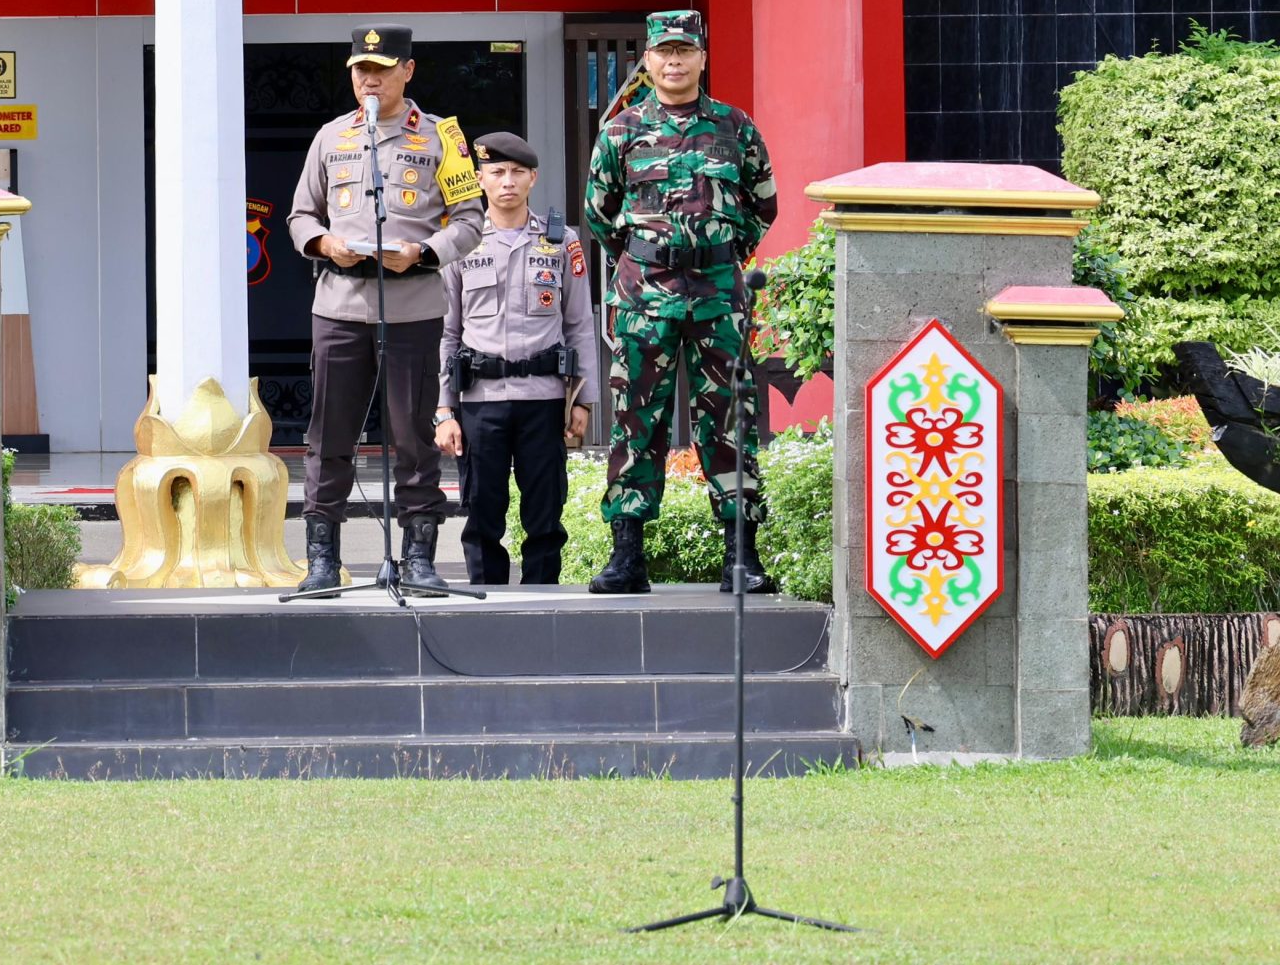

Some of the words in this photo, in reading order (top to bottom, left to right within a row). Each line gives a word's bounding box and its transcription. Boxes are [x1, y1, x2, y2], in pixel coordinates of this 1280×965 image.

[396, 153, 431, 167] POLRI
[444, 169, 476, 188] WAKIL
[461, 257, 494, 271] AKBAR
[529, 256, 560, 269] POLRI
